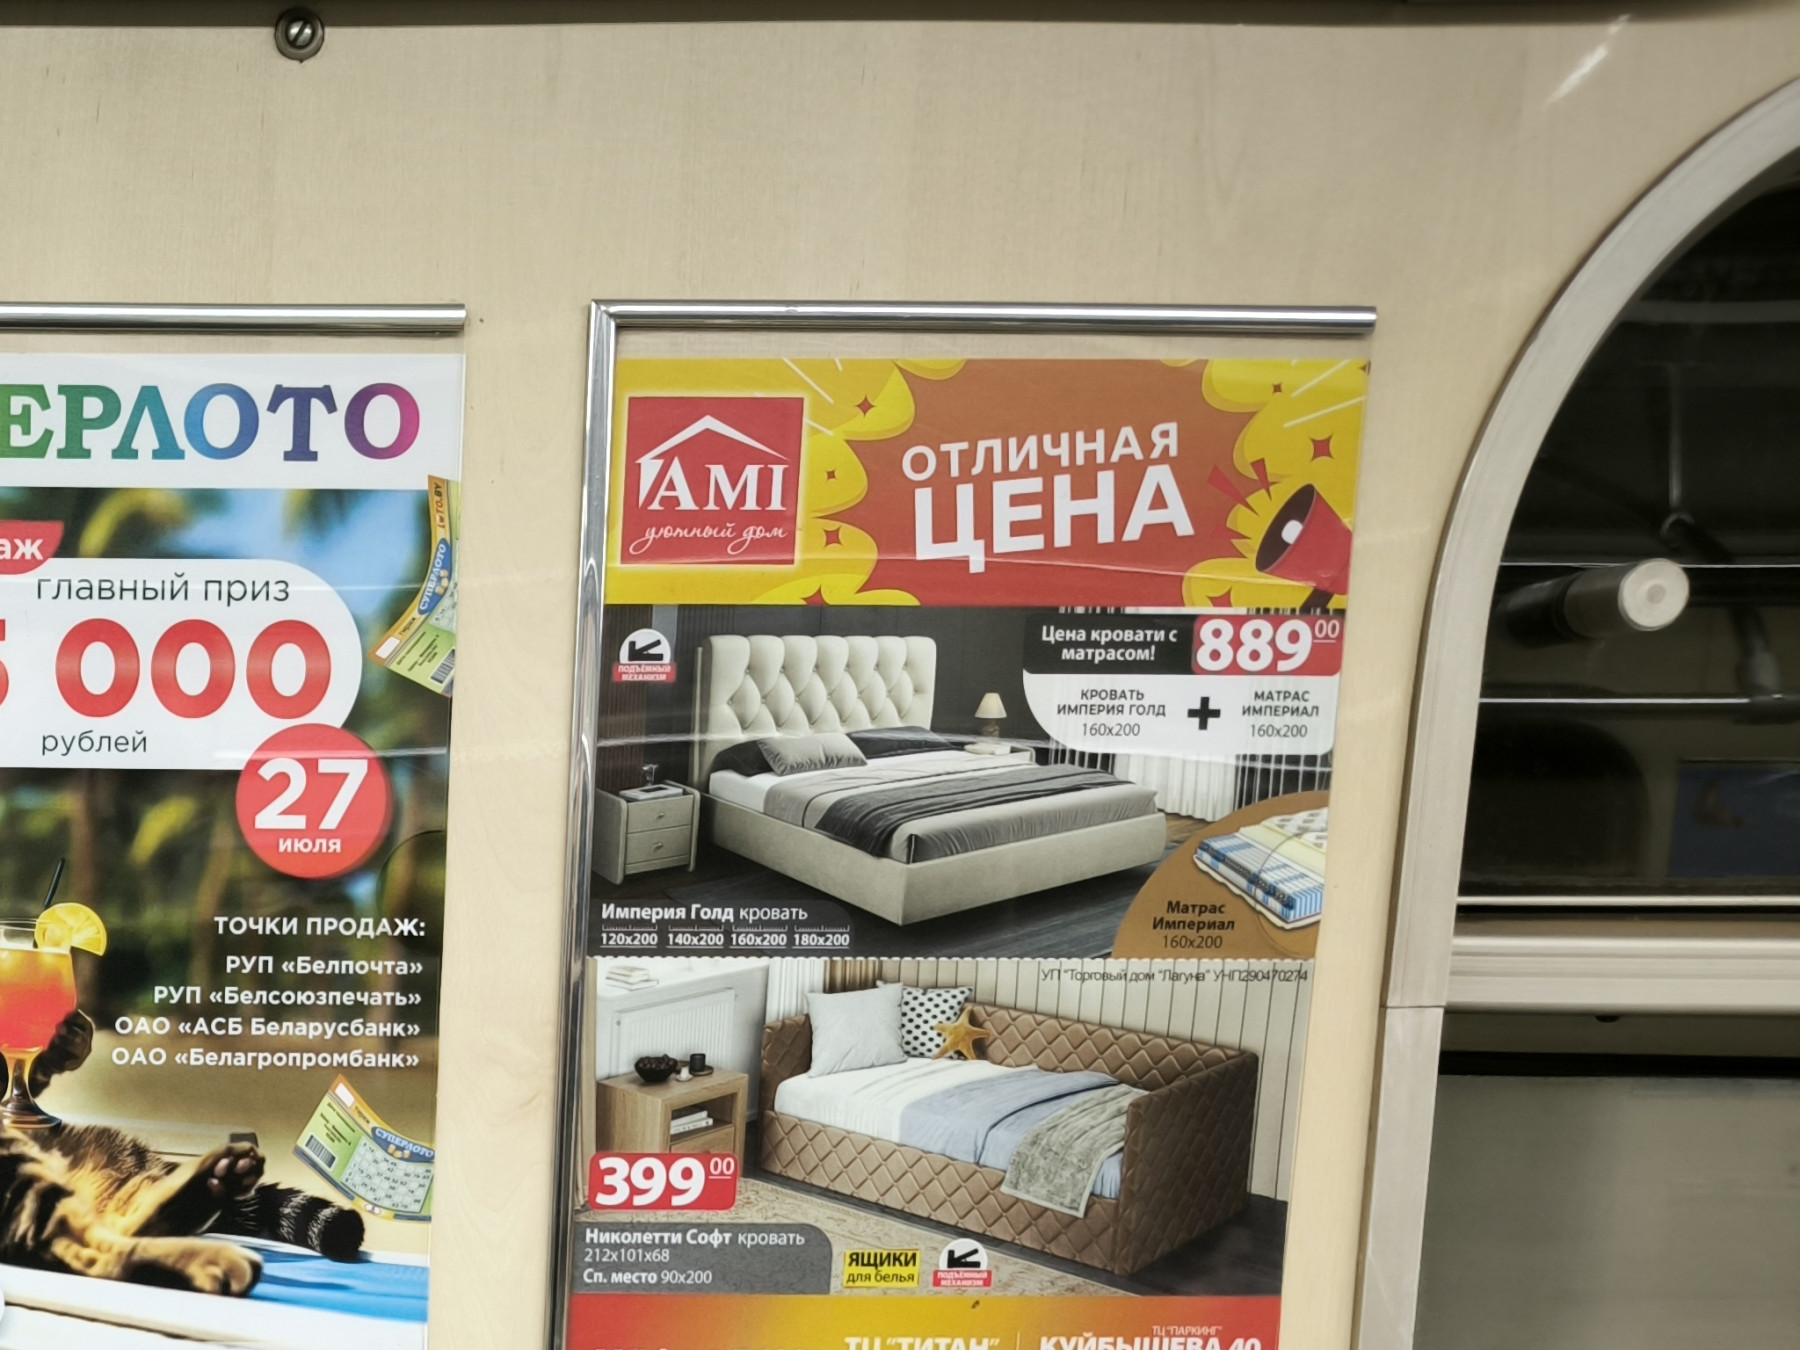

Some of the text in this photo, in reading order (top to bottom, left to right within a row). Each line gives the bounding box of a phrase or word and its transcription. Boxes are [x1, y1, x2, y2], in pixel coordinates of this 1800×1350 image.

[901, 422, 1179, 482] ОТЛИЧНАЯ
[914, 464, 1195, 573] ЦЕНА
[629, 523, 787, 555] уютный дом
[419, 544, 446, 610] СУПЕРЛОТО
[37, 572, 289, 607] главный приз
[1042, 626, 1177, 646] Цена кровати с
[1196, 618, 1340, 672] 889 00
[1062, 646, 1155, 664] матрасом!
[55, 617, 332, 719] 000
[1081, 689, 1144, 700] КРОВАТЬ
[1254, 691, 1309, 702] МАТРАС
[1057, 704, 1166, 717] ИМПЕРИЯ ГОЛД
[1242, 705, 1319, 717] ИМПЕРИАЛ
[42, 730, 146, 756] рублей
[255, 758, 369, 855] 27 июля
[602, 903, 807, 923] Империя Голд кровать
[213, 916, 425, 939] ТОЧКИ ПРОДАЖ:
[226, 955, 423, 975] РУП «Белпочта»
[154, 985, 421, 1005] РУП «Белсоюзпечать»
[115, 1016, 420, 1039] ОАО «АСБ Беларусбанк»
[111, 1047, 419, 1071] ОАО «Белагропромбанк»
[375, 1128, 433, 1158] СУПЕРЛОТО
[595, 1157, 736, 1207] 399 00
[585, 1228, 804, 1248] Николетти Софт кровать
[848, 1252, 917, 1269] ЯЩИКИ
[846, 1270, 915, 1285] для белья
